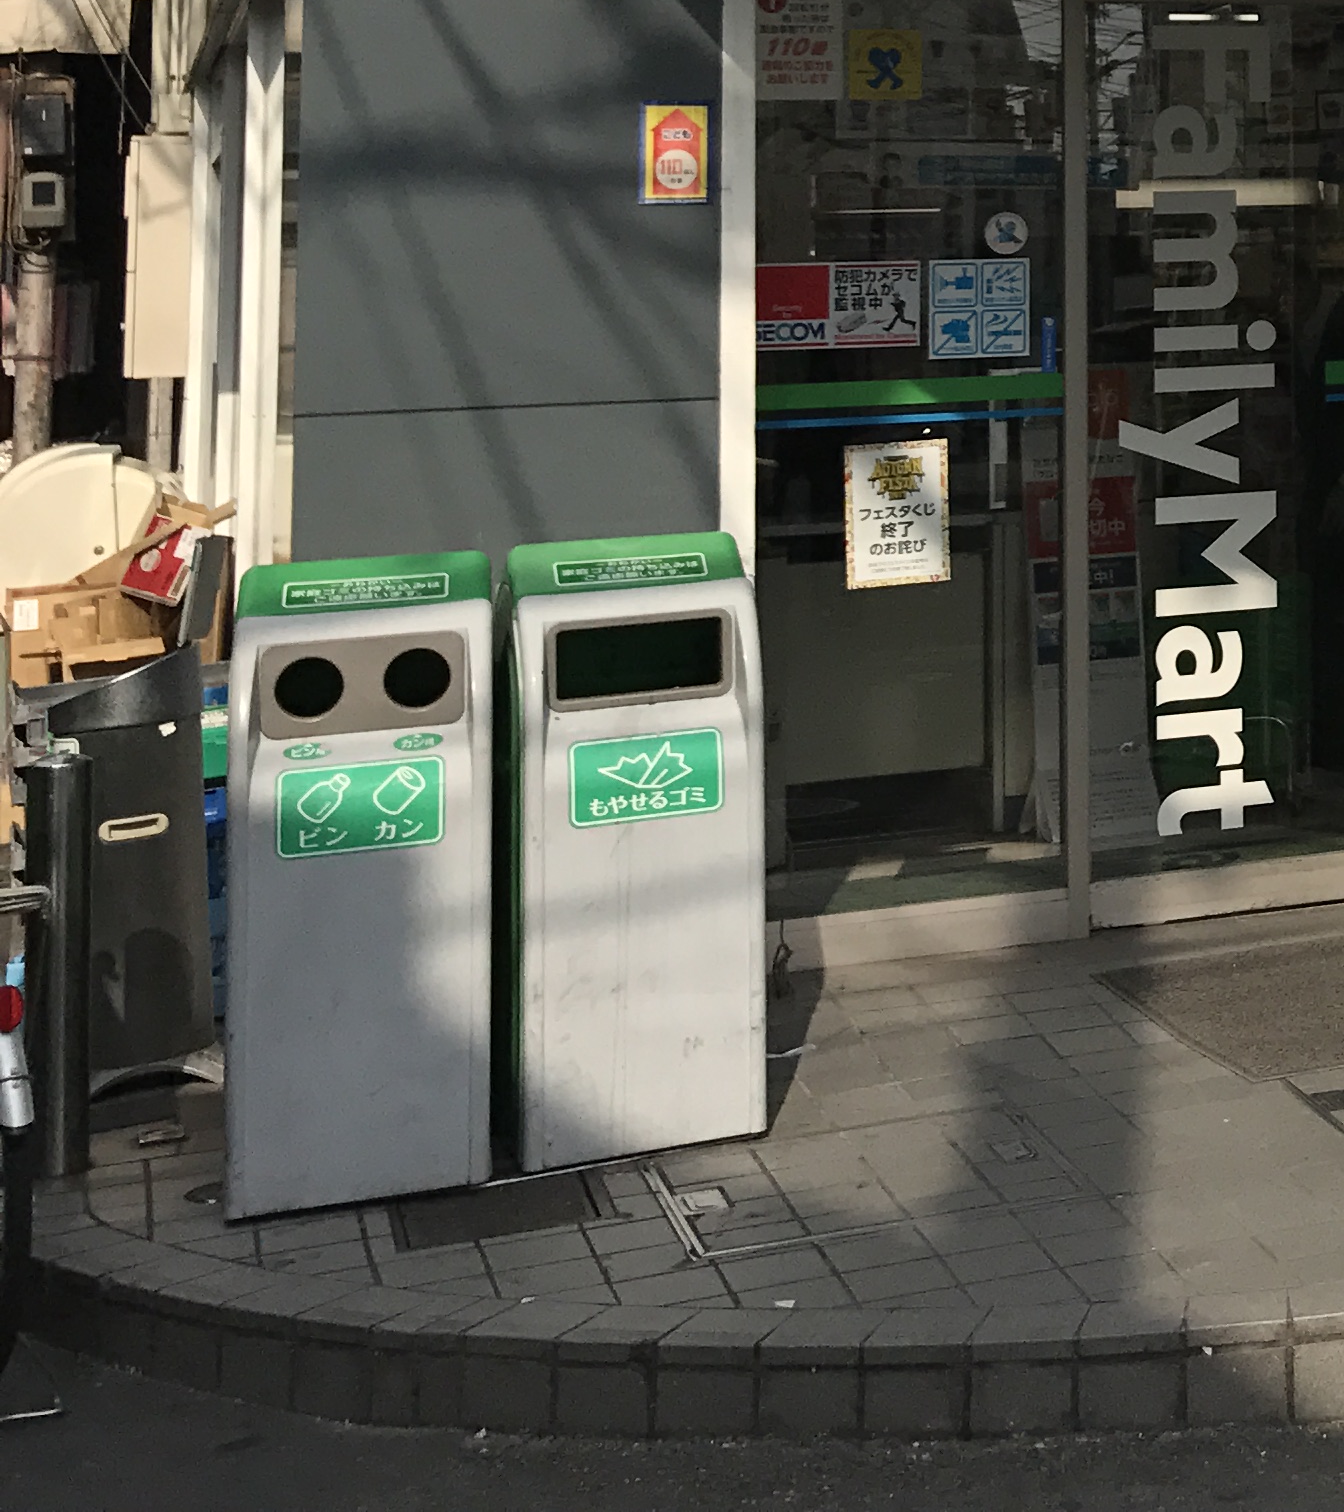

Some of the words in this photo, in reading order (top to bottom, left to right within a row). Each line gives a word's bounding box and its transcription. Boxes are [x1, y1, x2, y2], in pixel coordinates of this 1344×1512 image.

[834, 268, 917, 284] 防犯カメラで
[834, 284, 896, 297] セコムが
[834, 296, 883, 311] 監視中
[1118, 24, 1277, 837] FamilyMart
[860, 503, 936, 521] フェスタくじ
[880, 521, 915, 539] 終了
[870, 539, 927, 556] のお詫び
[589, 788, 706, 816] もやせるゴミ
[300, 827, 348, 848] ビン
[375, 818, 424, 841] カン
